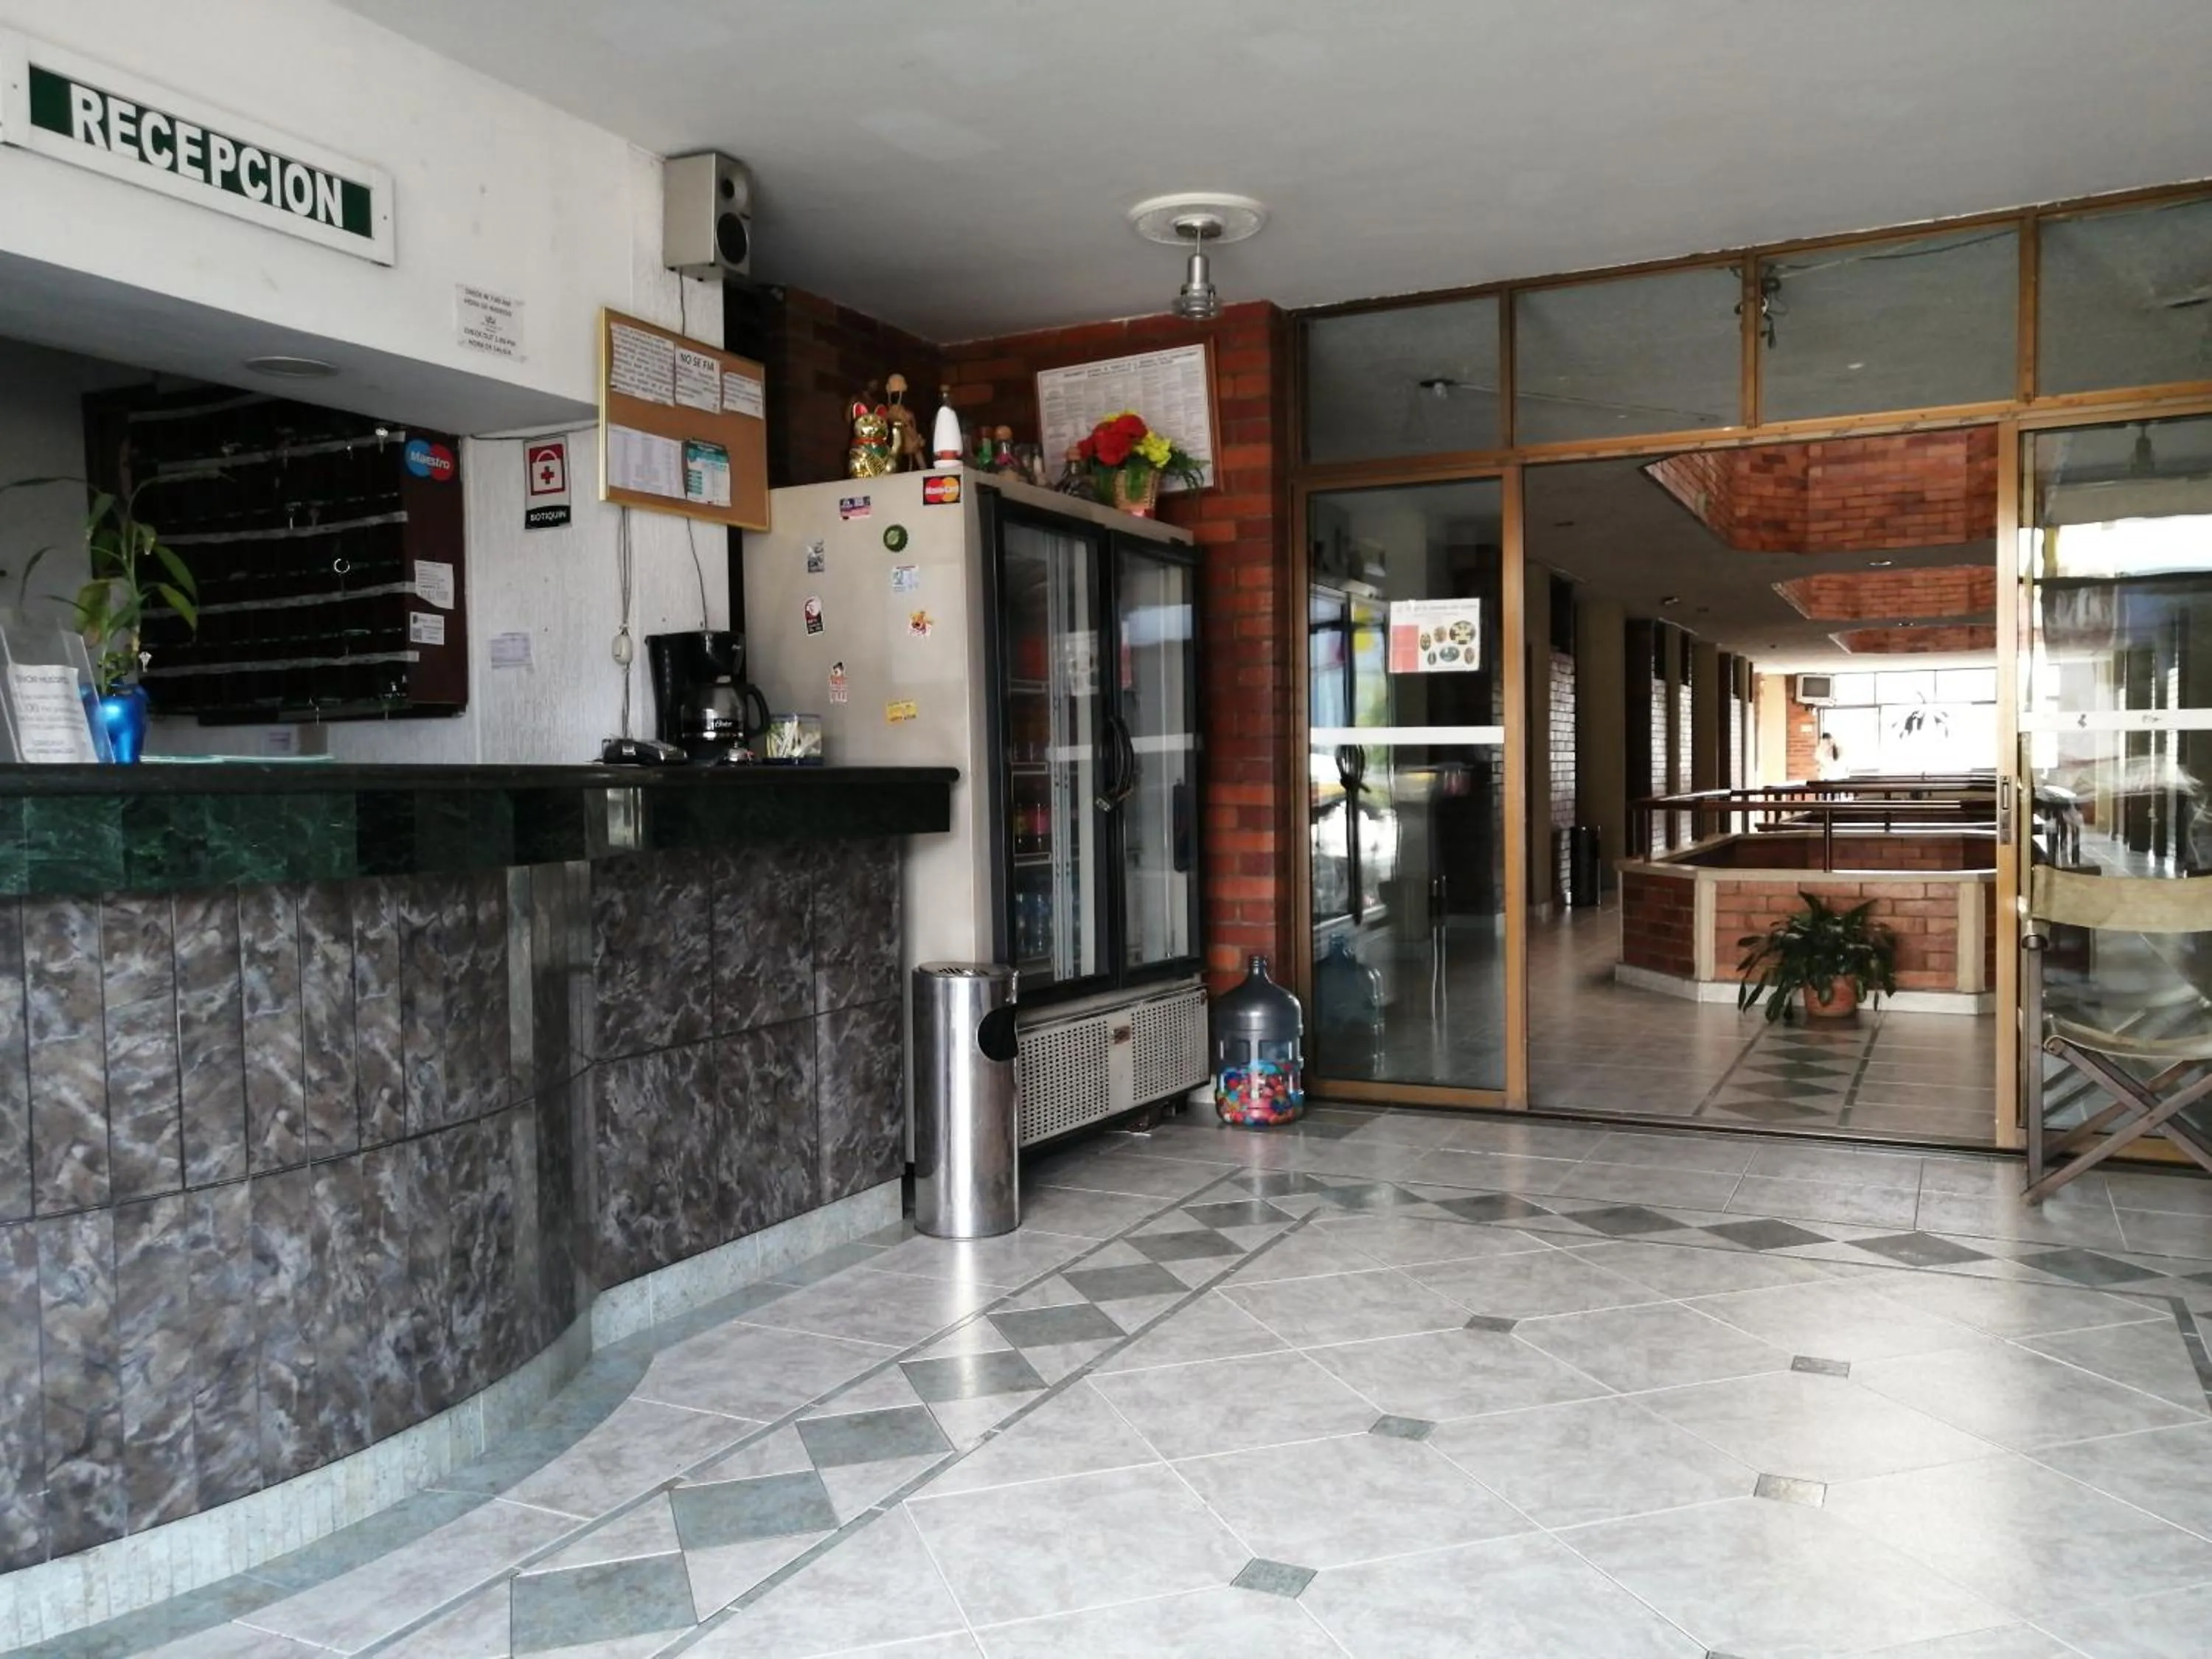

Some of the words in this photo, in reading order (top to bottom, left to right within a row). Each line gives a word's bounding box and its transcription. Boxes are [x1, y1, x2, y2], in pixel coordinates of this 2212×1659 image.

[70, 83, 344, 228] RECEPCION
[680, 352, 692, 365] NO
[693, 355, 701, 368] SE
[411, 451, 451, 470] Maestro
